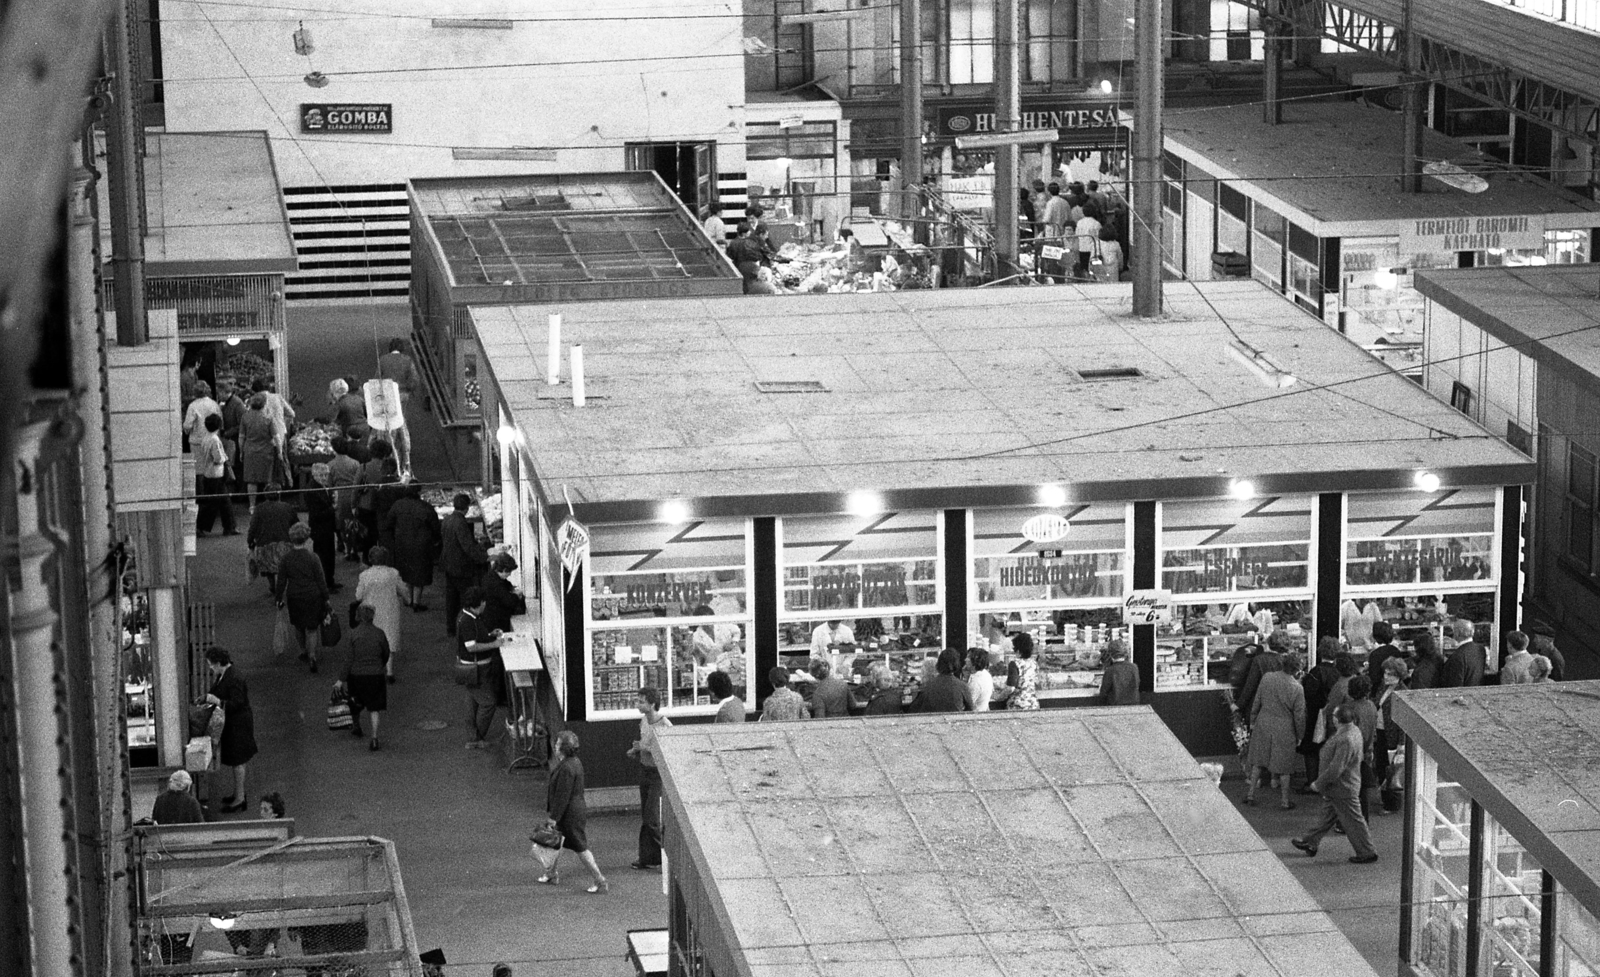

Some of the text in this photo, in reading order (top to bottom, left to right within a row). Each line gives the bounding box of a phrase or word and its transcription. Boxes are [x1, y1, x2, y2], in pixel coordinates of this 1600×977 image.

[327, 111, 388, 124] GOMBA
[1022, 105, 1118, 130] HENTESÁ
[178, 312, 258, 330] ETKEZET
